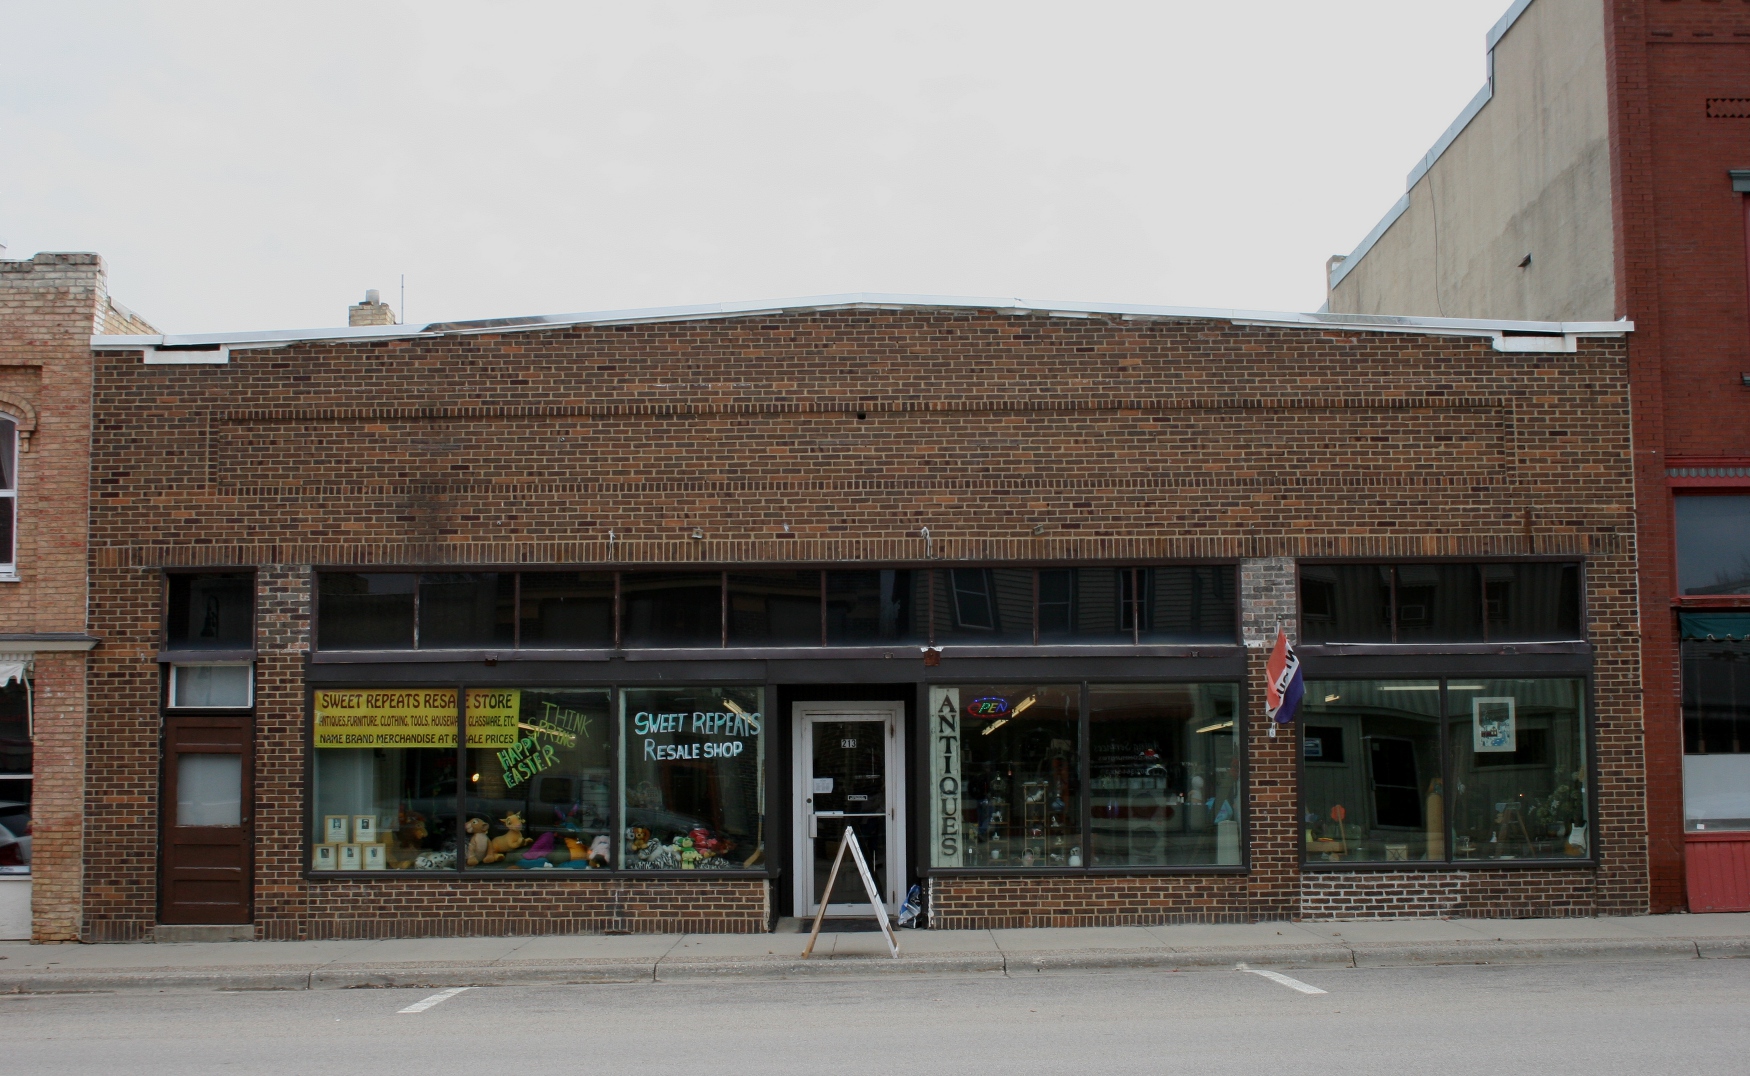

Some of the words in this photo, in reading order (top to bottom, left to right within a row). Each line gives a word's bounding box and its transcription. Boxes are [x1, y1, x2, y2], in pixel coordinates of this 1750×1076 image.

[322, 693, 363, 709] SWEET
[366, 693, 420, 709] REPEATS
[424, 693, 470, 709] RESAE
[474, 693, 513, 709] STORE
[967, 702, 1007, 713] OPEN
[380, 715, 409, 727] CLOTHING,
[411, 715, 430, 727] TOOLS,
[468, 715, 502, 727] GLASSWARE,
[503, 715, 516, 727] ETC.
[542, 701, 592, 737] THINK
[634, 712, 688, 735] SWEET
[692, 712, 761, 737] REPEATS
[319, 734, 343, 744] NAME
[345, 734, 375, 744] BRAND
[376, 734, 436, 744] MERCHANDISE
[438, 734, 450, 744] AT
[485, 734, 514, 744] PRICES
[525, 717, 576, 748] SPRING
[497, 729, 540, 771] HAPPY
[703, 741, 743, 758] SHOP
[842, 740, 856, 749] 213
[503, 745, 560, 789] EASTER
[938, 694, 959, 856] ANTIQUES
